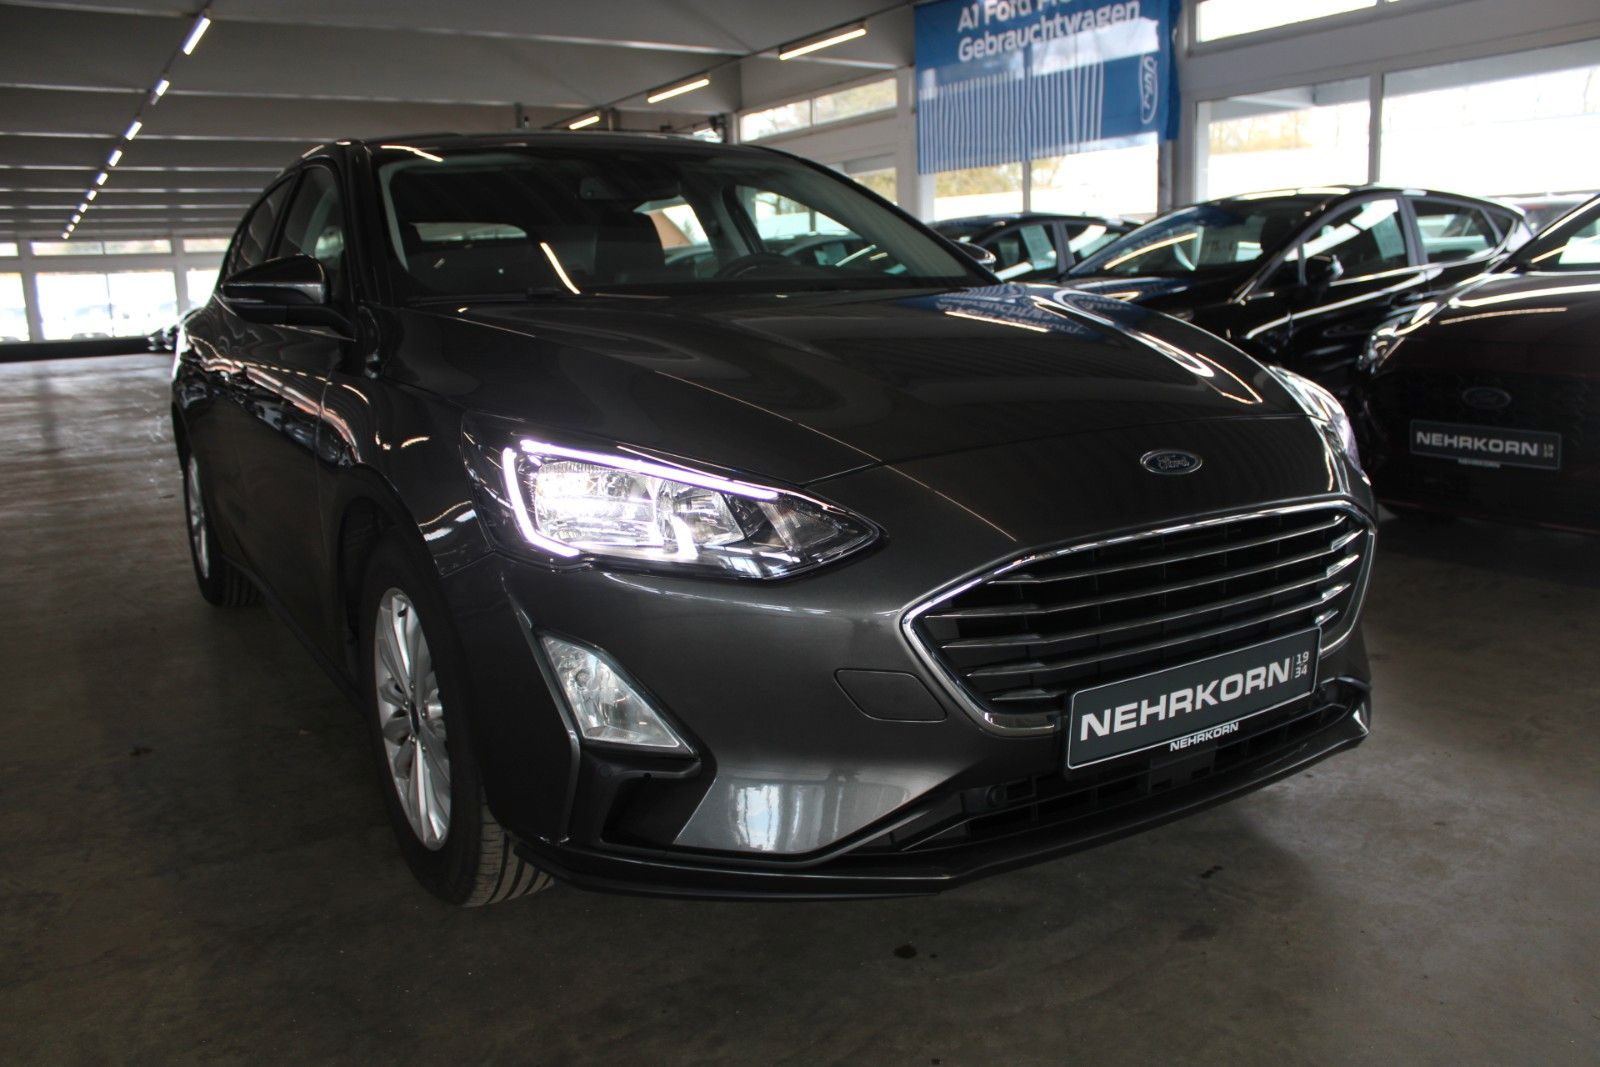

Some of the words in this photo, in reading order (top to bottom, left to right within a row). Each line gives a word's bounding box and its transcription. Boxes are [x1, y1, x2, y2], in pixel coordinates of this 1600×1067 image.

[957, 1, 1140, 62] Gebrauchtwagen
[1416, 431, 1538, 457] NEHRKORN
[1080, 658, 1291, 741] NEHRKORN
[1170, 721, 1239, 752] NEHRKORN
